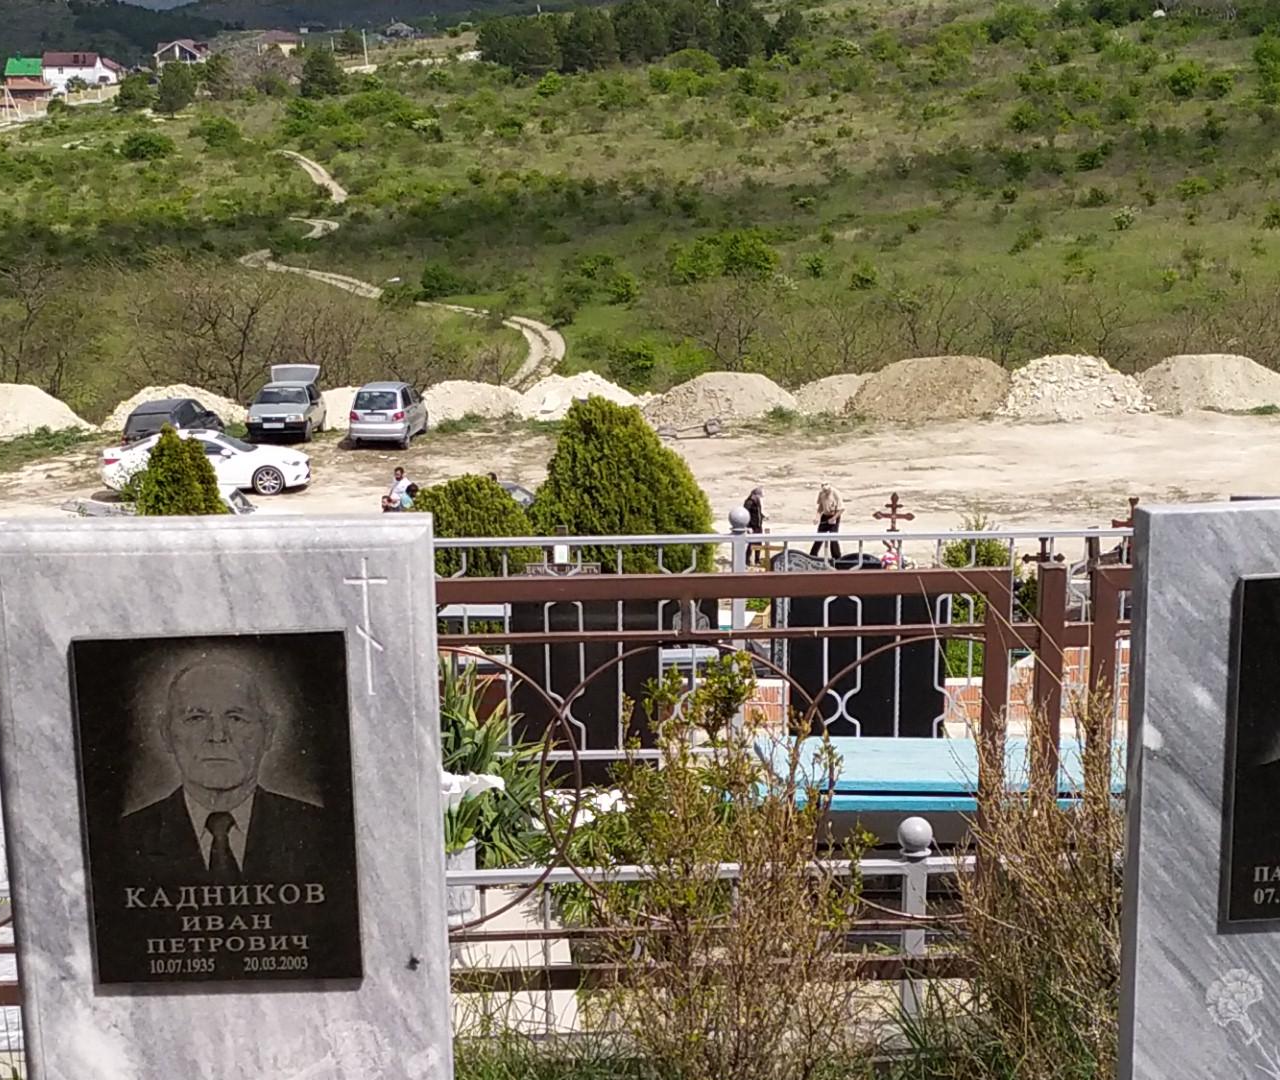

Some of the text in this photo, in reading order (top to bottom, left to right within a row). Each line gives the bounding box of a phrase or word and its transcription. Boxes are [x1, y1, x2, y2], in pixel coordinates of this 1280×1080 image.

[125, 884, 326, 910] КАДНИКОВ
[181, 914, 273, 932] ИВАН
[146, 935, 310, 954] ПЕТРОВИЧ
[150, 956, 309, 974] 10.07.1935 20.03.2003
